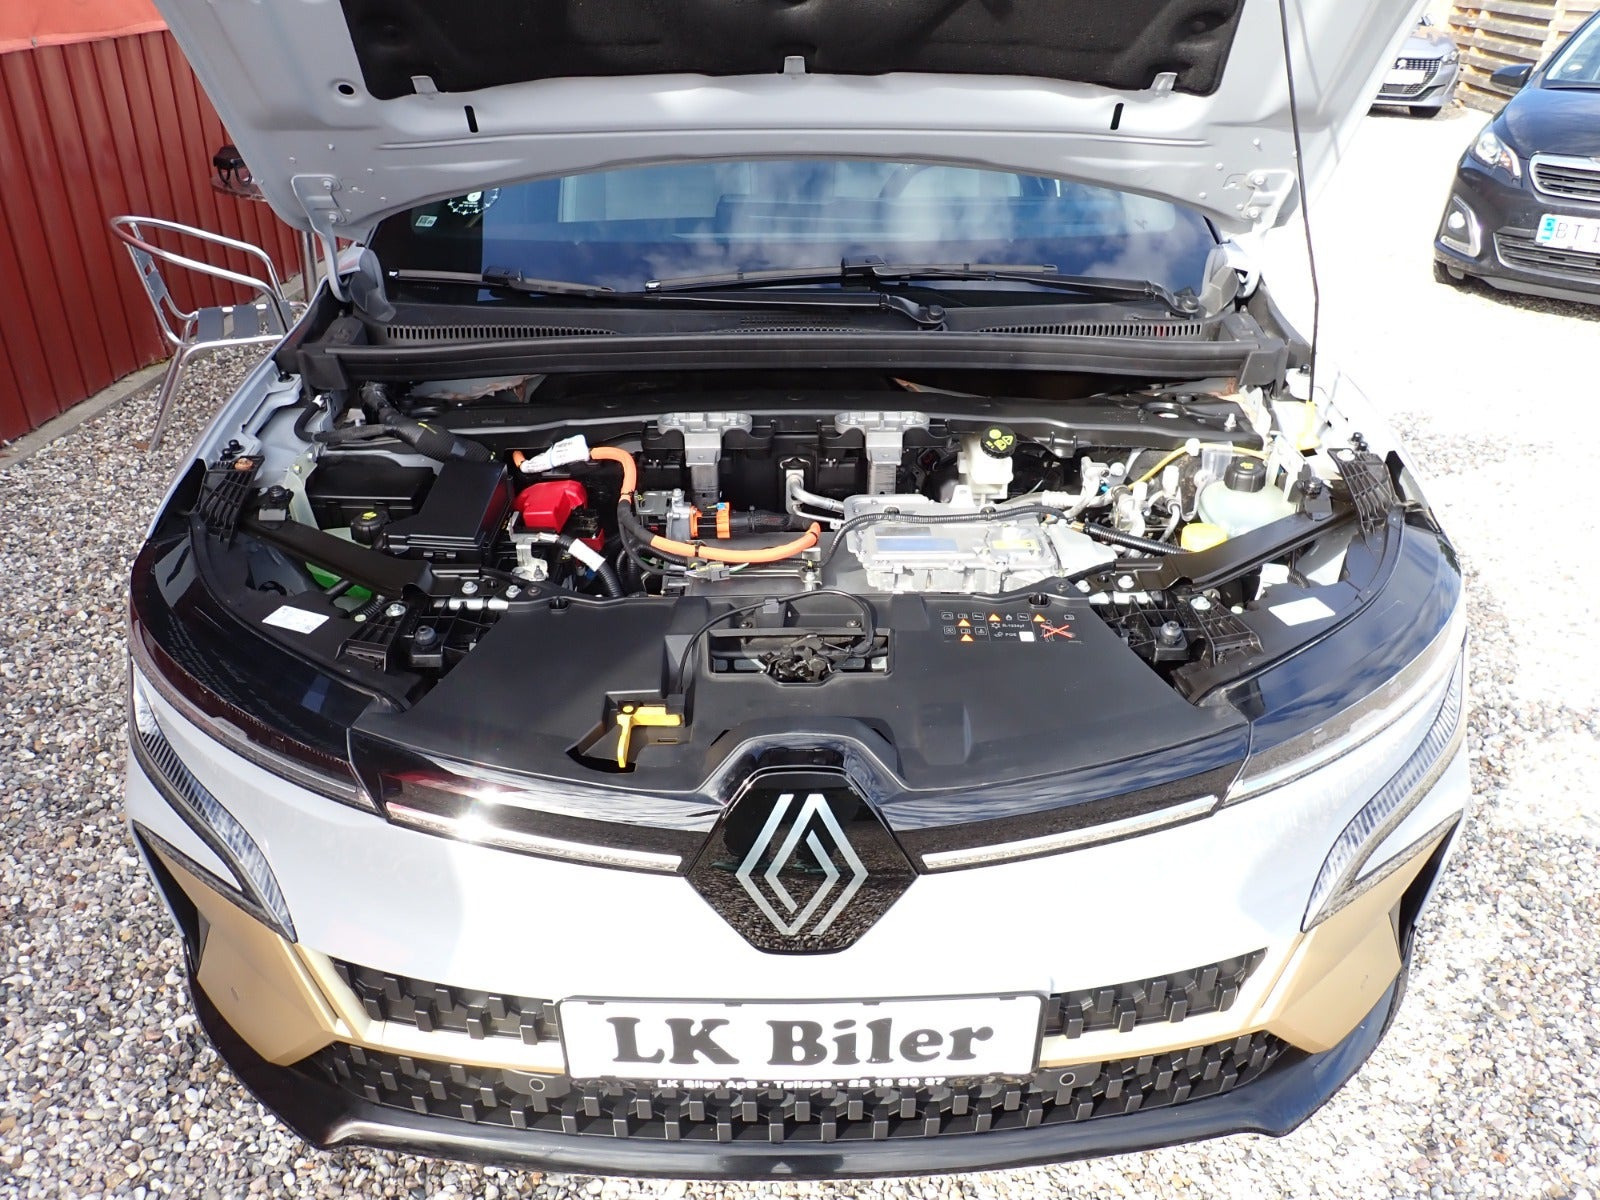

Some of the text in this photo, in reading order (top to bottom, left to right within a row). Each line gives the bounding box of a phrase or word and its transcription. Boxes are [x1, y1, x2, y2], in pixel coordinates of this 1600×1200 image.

[1555, 222, 1584, 240] BT
[606, 1016, 994, 1066] LK Biler
[657, 1079, 679, 1088] LK
[683, 1079, 721, 1089] Biler
[725, 1080, 757, 1090] ApS
